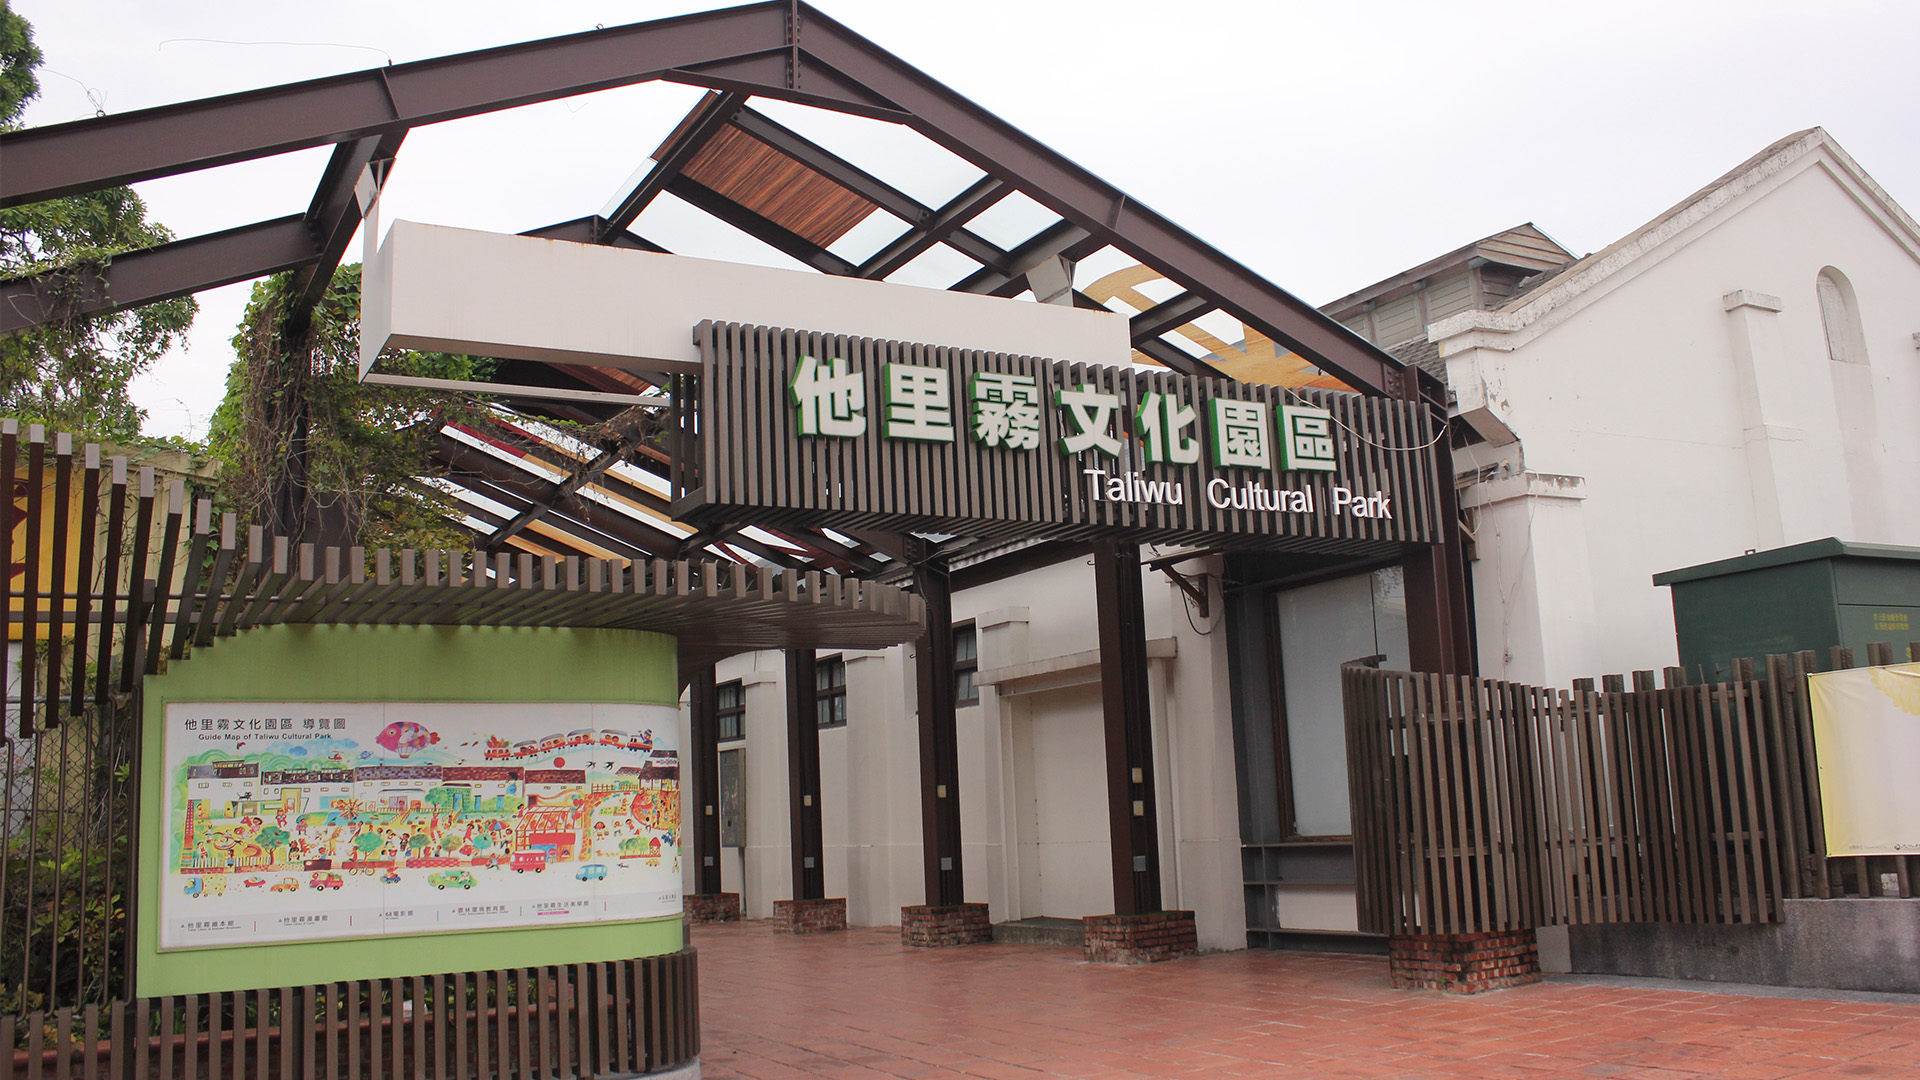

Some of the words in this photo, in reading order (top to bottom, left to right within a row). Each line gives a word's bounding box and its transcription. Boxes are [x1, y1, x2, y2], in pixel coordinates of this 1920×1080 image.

[789, 355, 1338, 474] 他里霧文化園區
[1083, 467, 1184, 506] Taliwu
[1207, 478, 1315, 515] Cultural
[1332, 486, 1393, 520] Park
[184, 718, 293, 731] 他里霧文化園區
[302, 718, 346, 730] 導覽圖
[198, 733, 222, 741] Guide
[224, 733, 241, 741] Map
